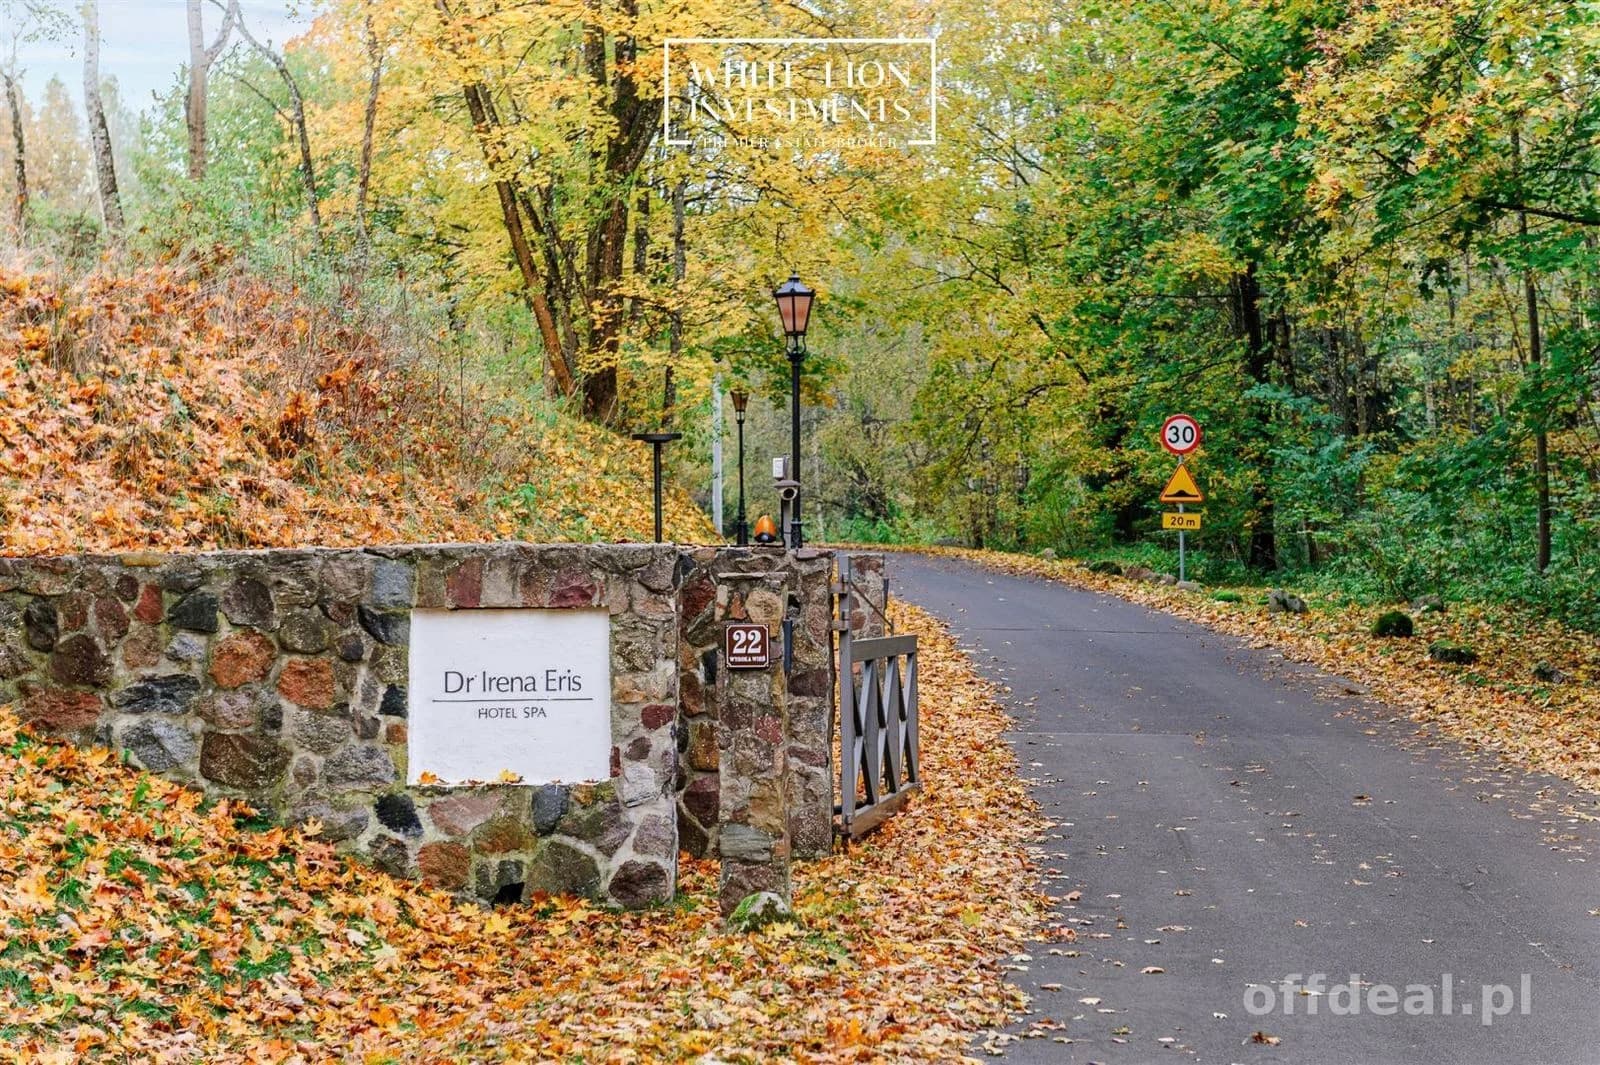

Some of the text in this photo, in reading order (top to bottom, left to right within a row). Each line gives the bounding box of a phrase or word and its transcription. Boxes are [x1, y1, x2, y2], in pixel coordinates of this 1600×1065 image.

[1168, 426, 1195, 443] 30
[1170, 516, 1184, 526] 20
[732, 630, 762, 654] 22
[444, 669, 582, 693] Dr Irena Eris
[478, 707, 547, 719] HOTEL SPA
